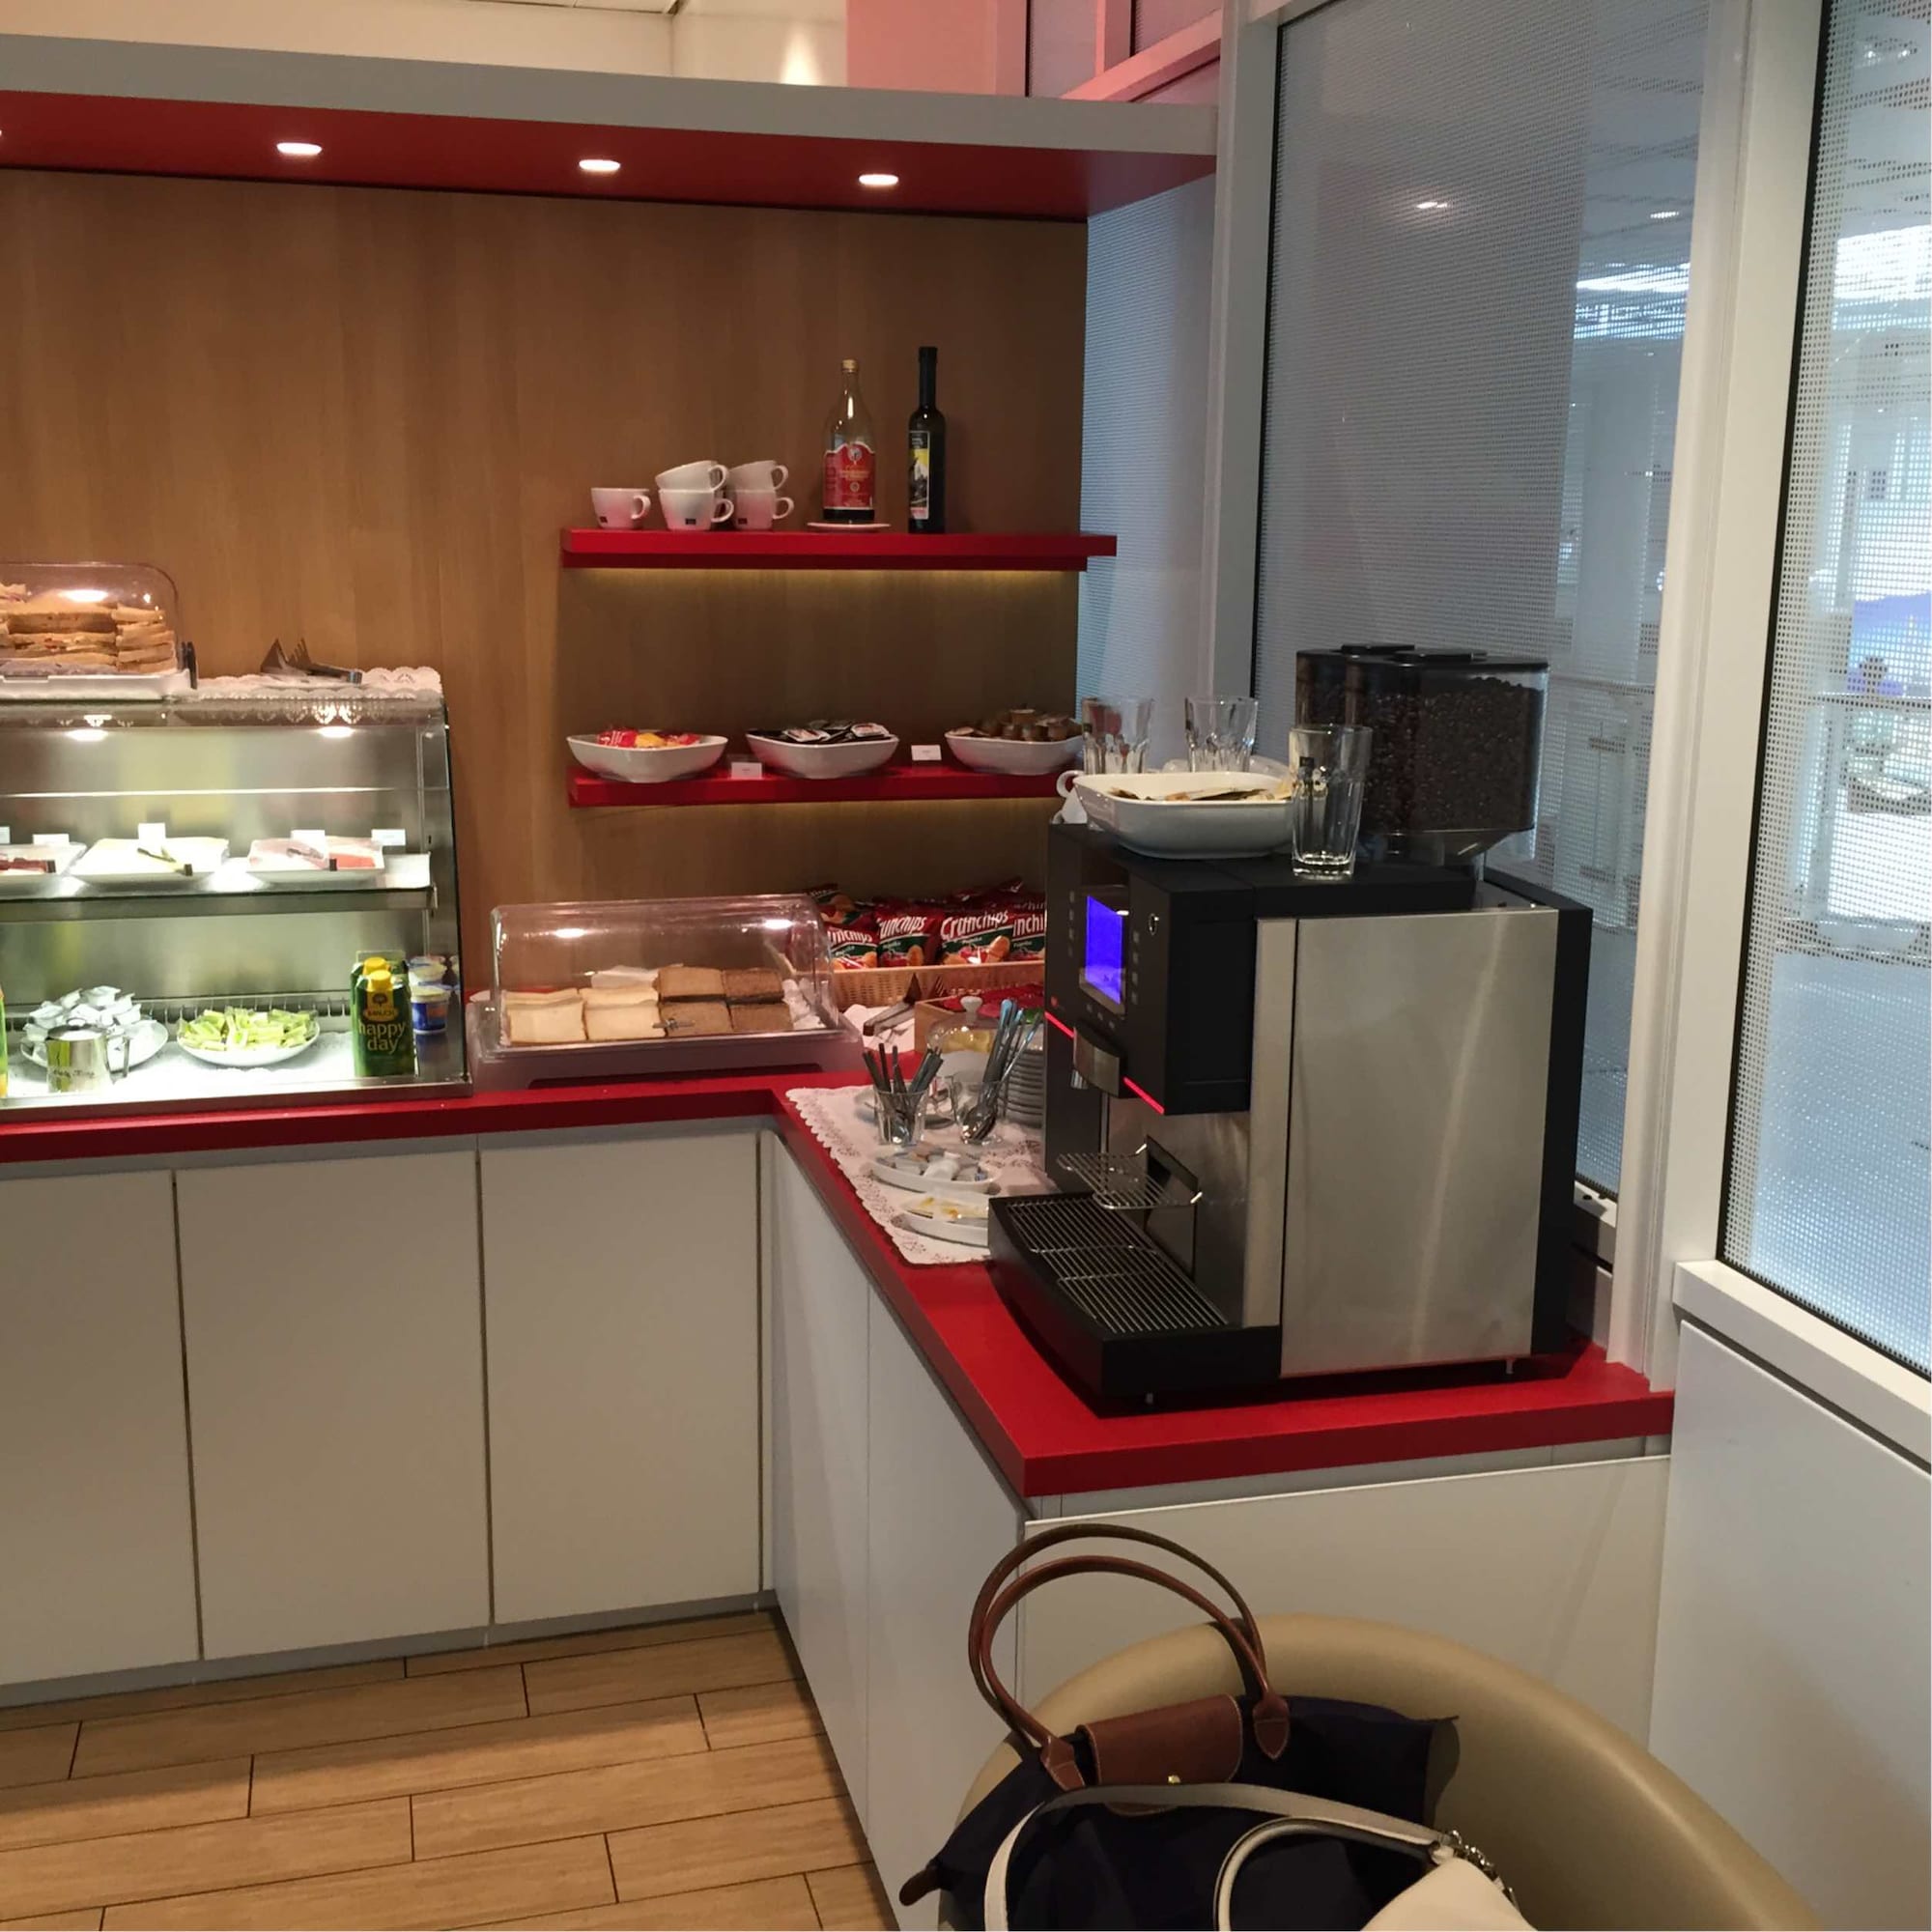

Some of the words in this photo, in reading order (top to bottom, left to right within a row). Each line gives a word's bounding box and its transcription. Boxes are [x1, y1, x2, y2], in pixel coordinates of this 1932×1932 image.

[940, 910, 1009, 941] Crunchips
[358, 1018, 406, 1039] happy
[367, 1037, 400, 1055] day
